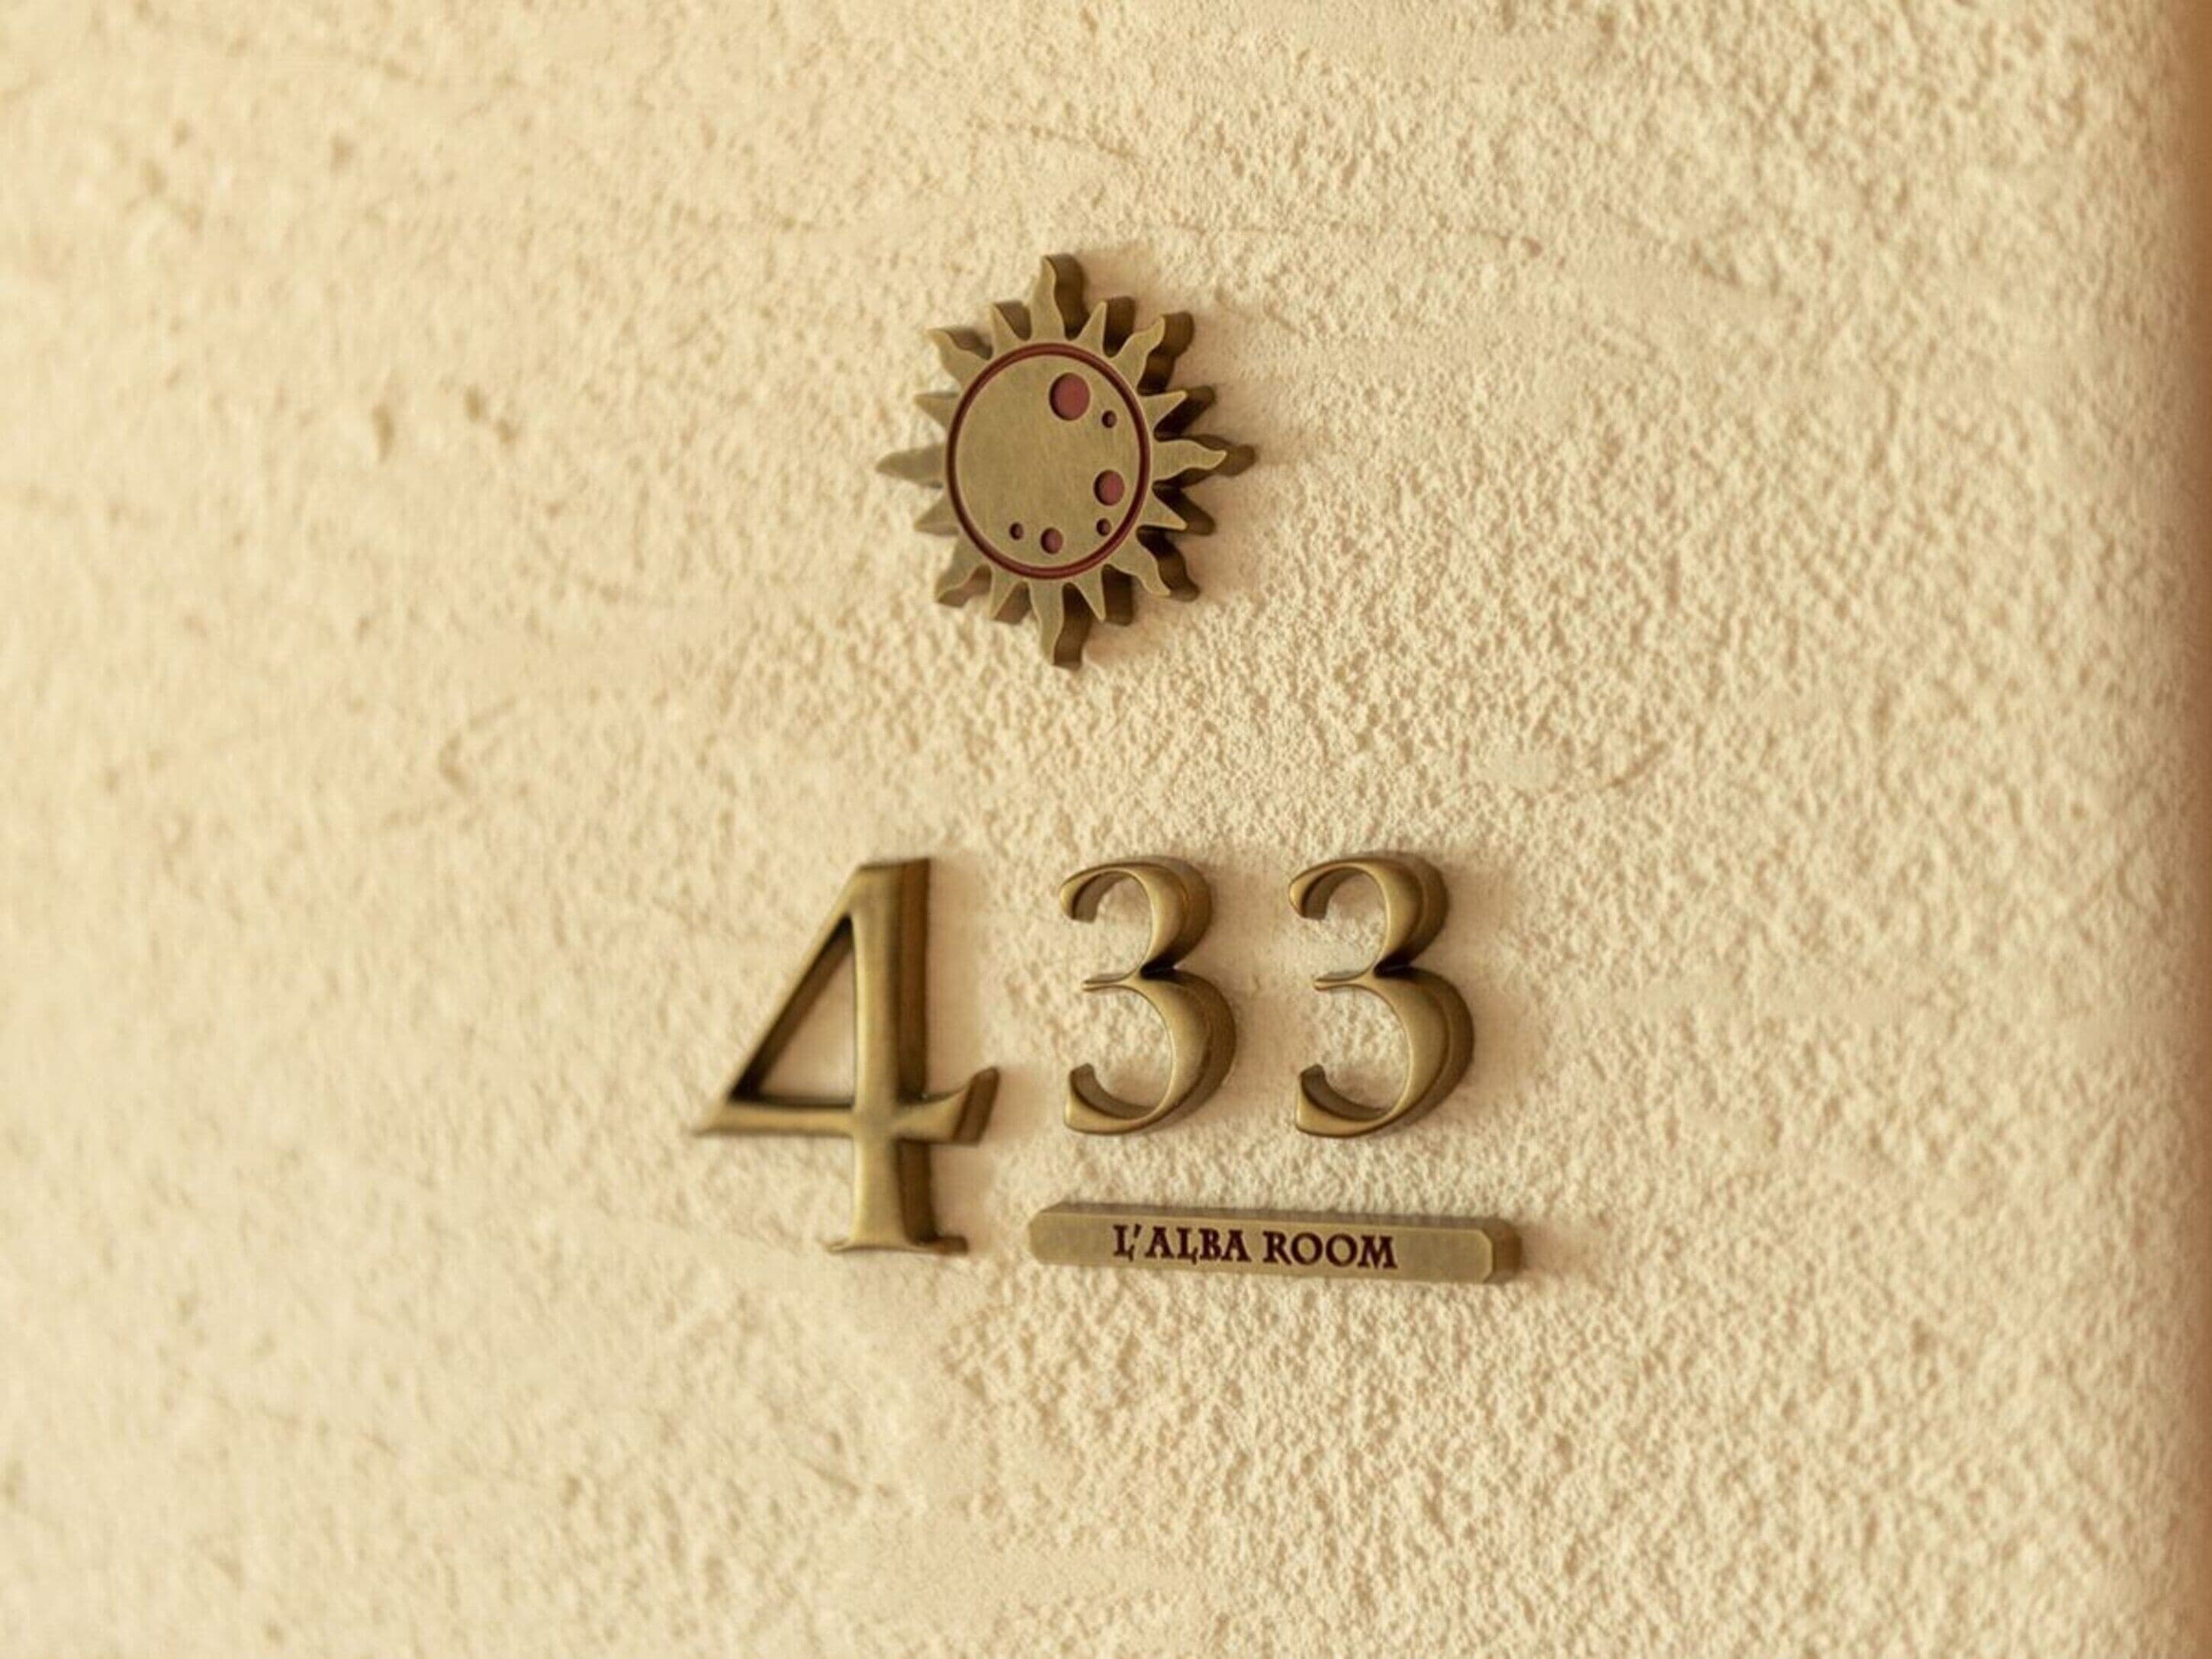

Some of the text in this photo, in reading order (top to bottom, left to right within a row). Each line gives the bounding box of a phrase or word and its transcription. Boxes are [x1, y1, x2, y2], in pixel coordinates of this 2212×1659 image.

[693, 855, 1475, 1254] 433
[1112, 1224, 1398, 1269] L'ALBA ROOM
